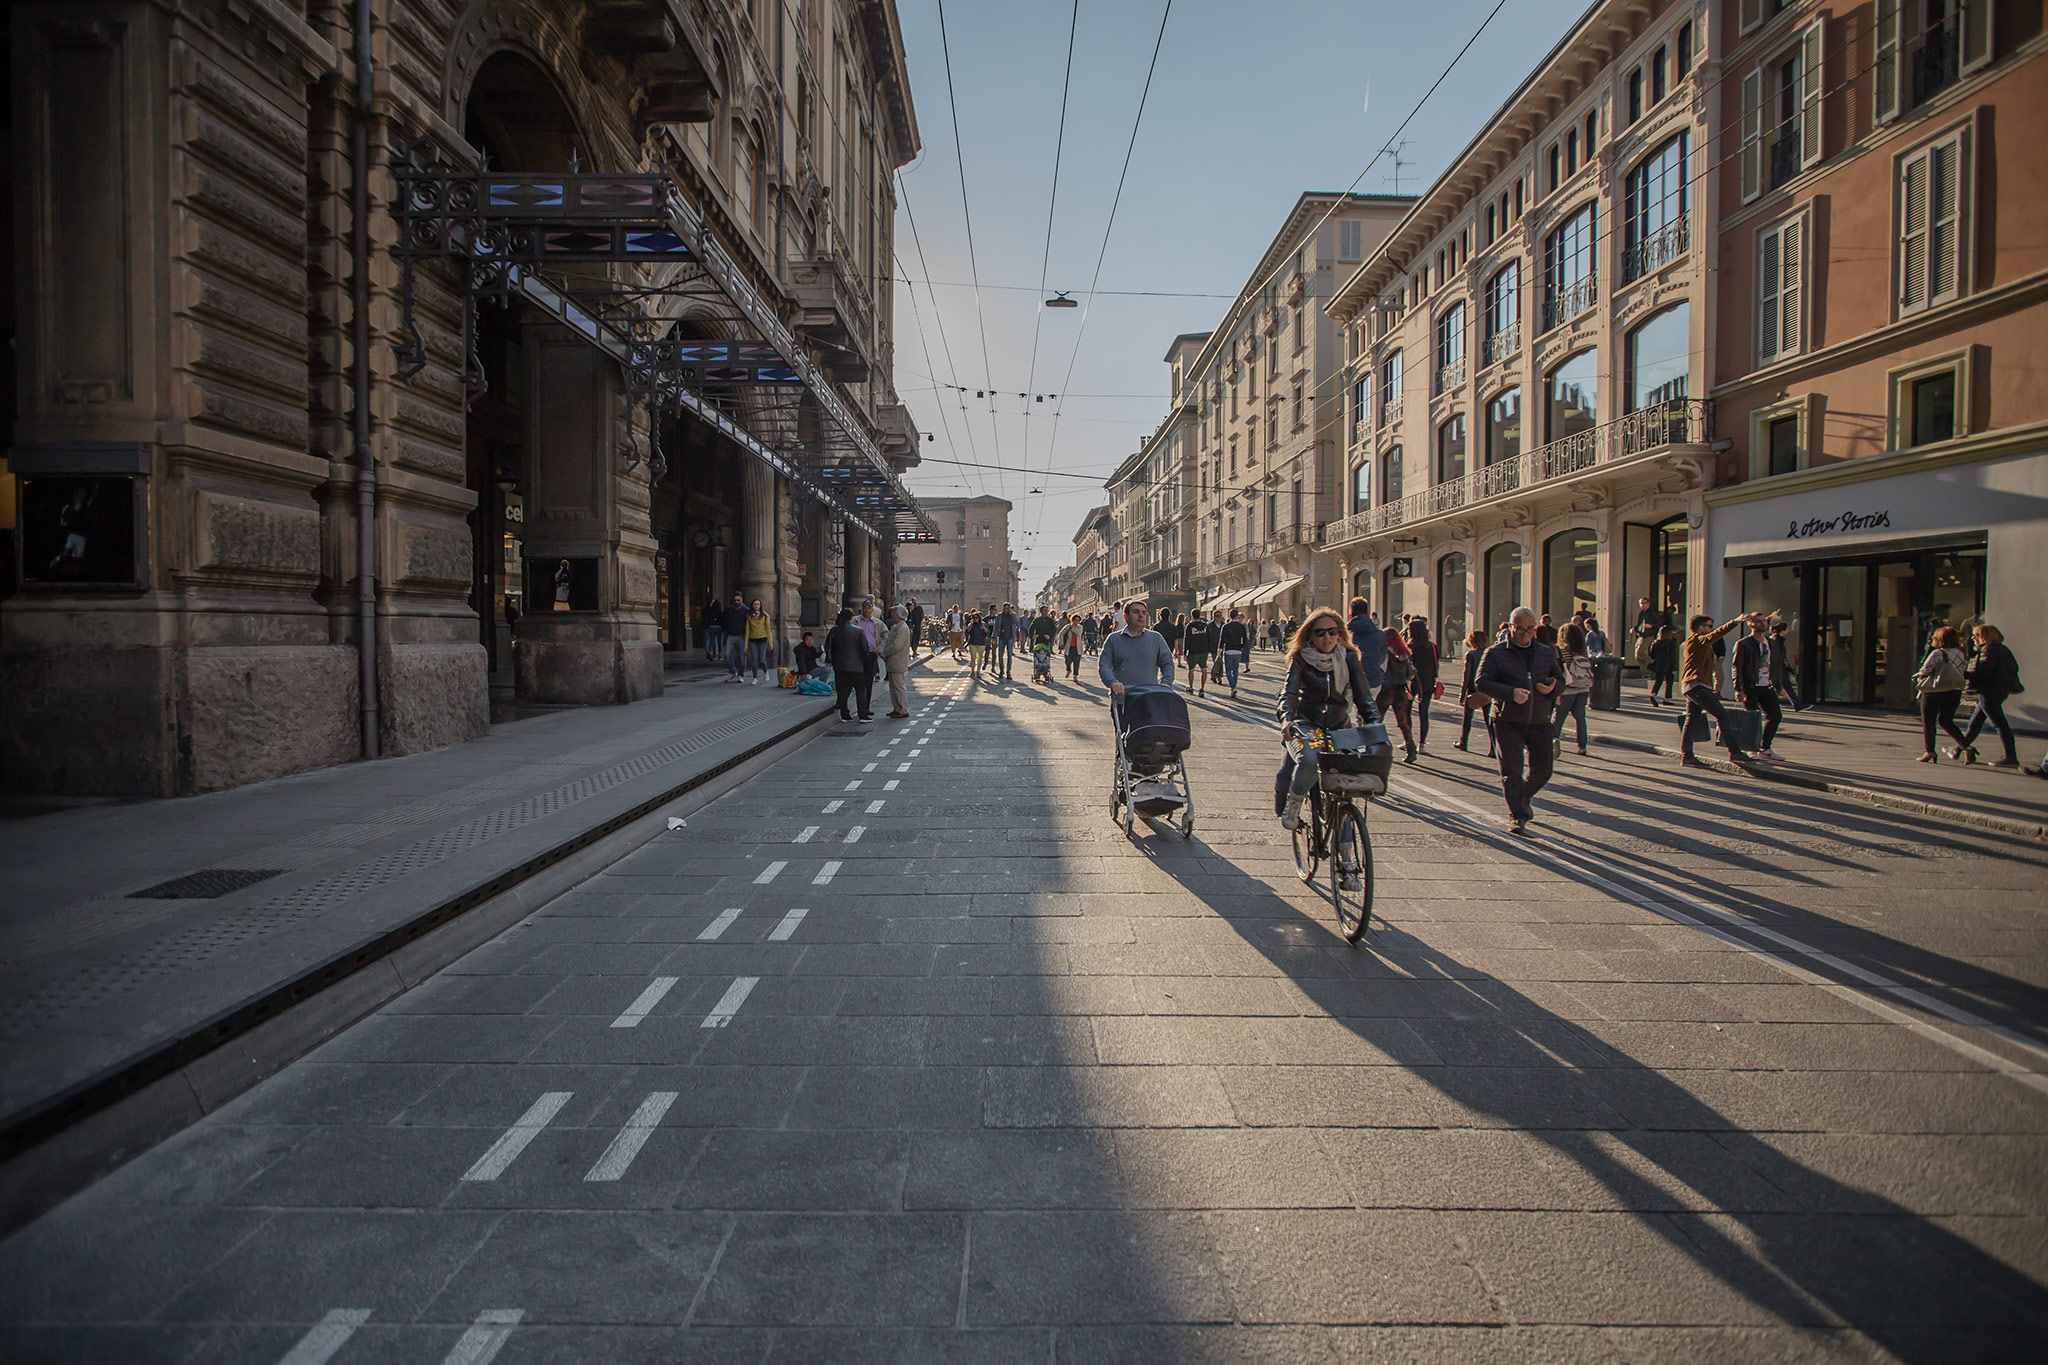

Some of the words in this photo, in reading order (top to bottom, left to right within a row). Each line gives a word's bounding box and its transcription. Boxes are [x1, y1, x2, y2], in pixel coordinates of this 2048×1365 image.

[1787, 521, 1800, 538] &
[1801, 517, 1840, 536] other
[1841, 511, 1890, 531] Stories
